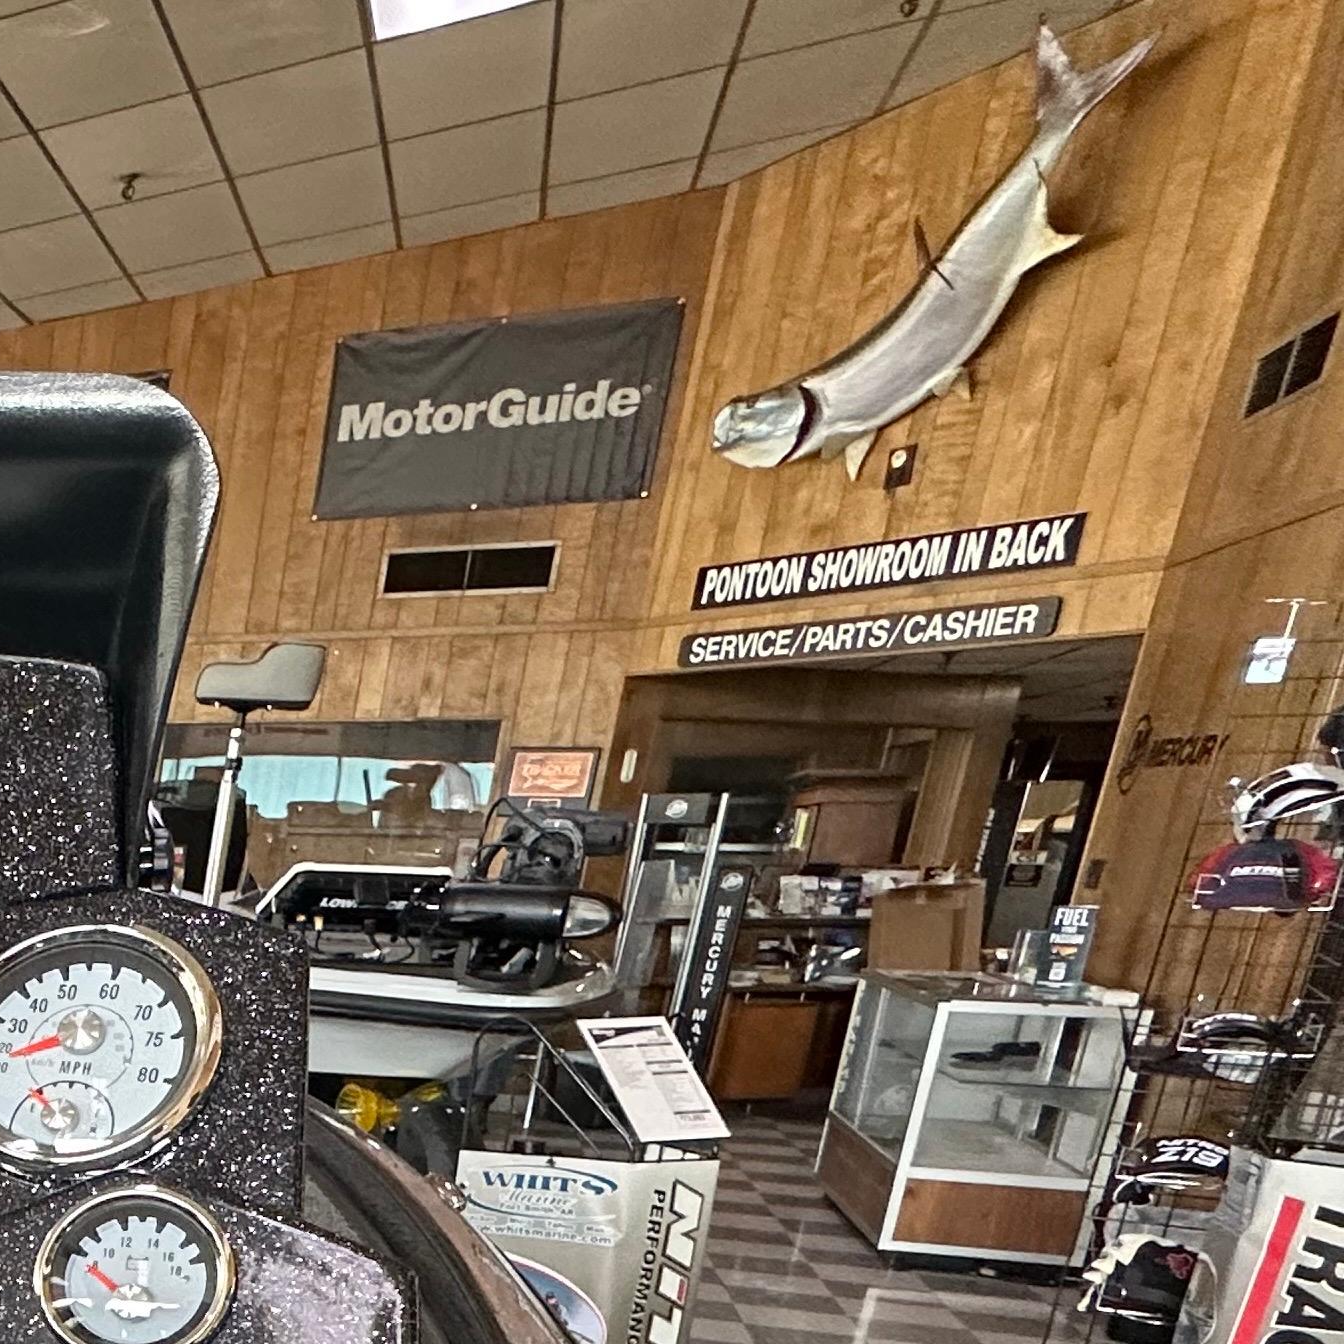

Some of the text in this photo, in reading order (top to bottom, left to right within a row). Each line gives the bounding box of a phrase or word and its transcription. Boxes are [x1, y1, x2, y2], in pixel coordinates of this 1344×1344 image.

[337, 379, 641, 442] MotorGuide
[700, 517, 1075, 605] PONTOON SHOWROOM IN BACK
[688, 603, 1040, 664] SERVICE/PARTS/CASHIER
[1054, 908, 1089, 926] FUEL
[700, 905, 732, 999] MERCURY
[57, 984, 77, 1000] 50
[99, 983, 119, 999] 60
[29, 998, 48, 1014] 40
[133, 1004, 153, 1020] 70
[8, 1018, 29, 1034] 30
[144, 1031, 163, 1047] 75
[59, 1061, 92, 1076] MPH
[137, 1067, 159, 1083] 80
[1151, 1146, 1224, 1168] Z19
[120, 1236, 132, 1248] 12
[147, 1238, 160, 1249] 14
[102, 1248, 115, 1259] 10
[162, 1252, 174, 1263] 16
[170, 1265, 182, 1276] 18
